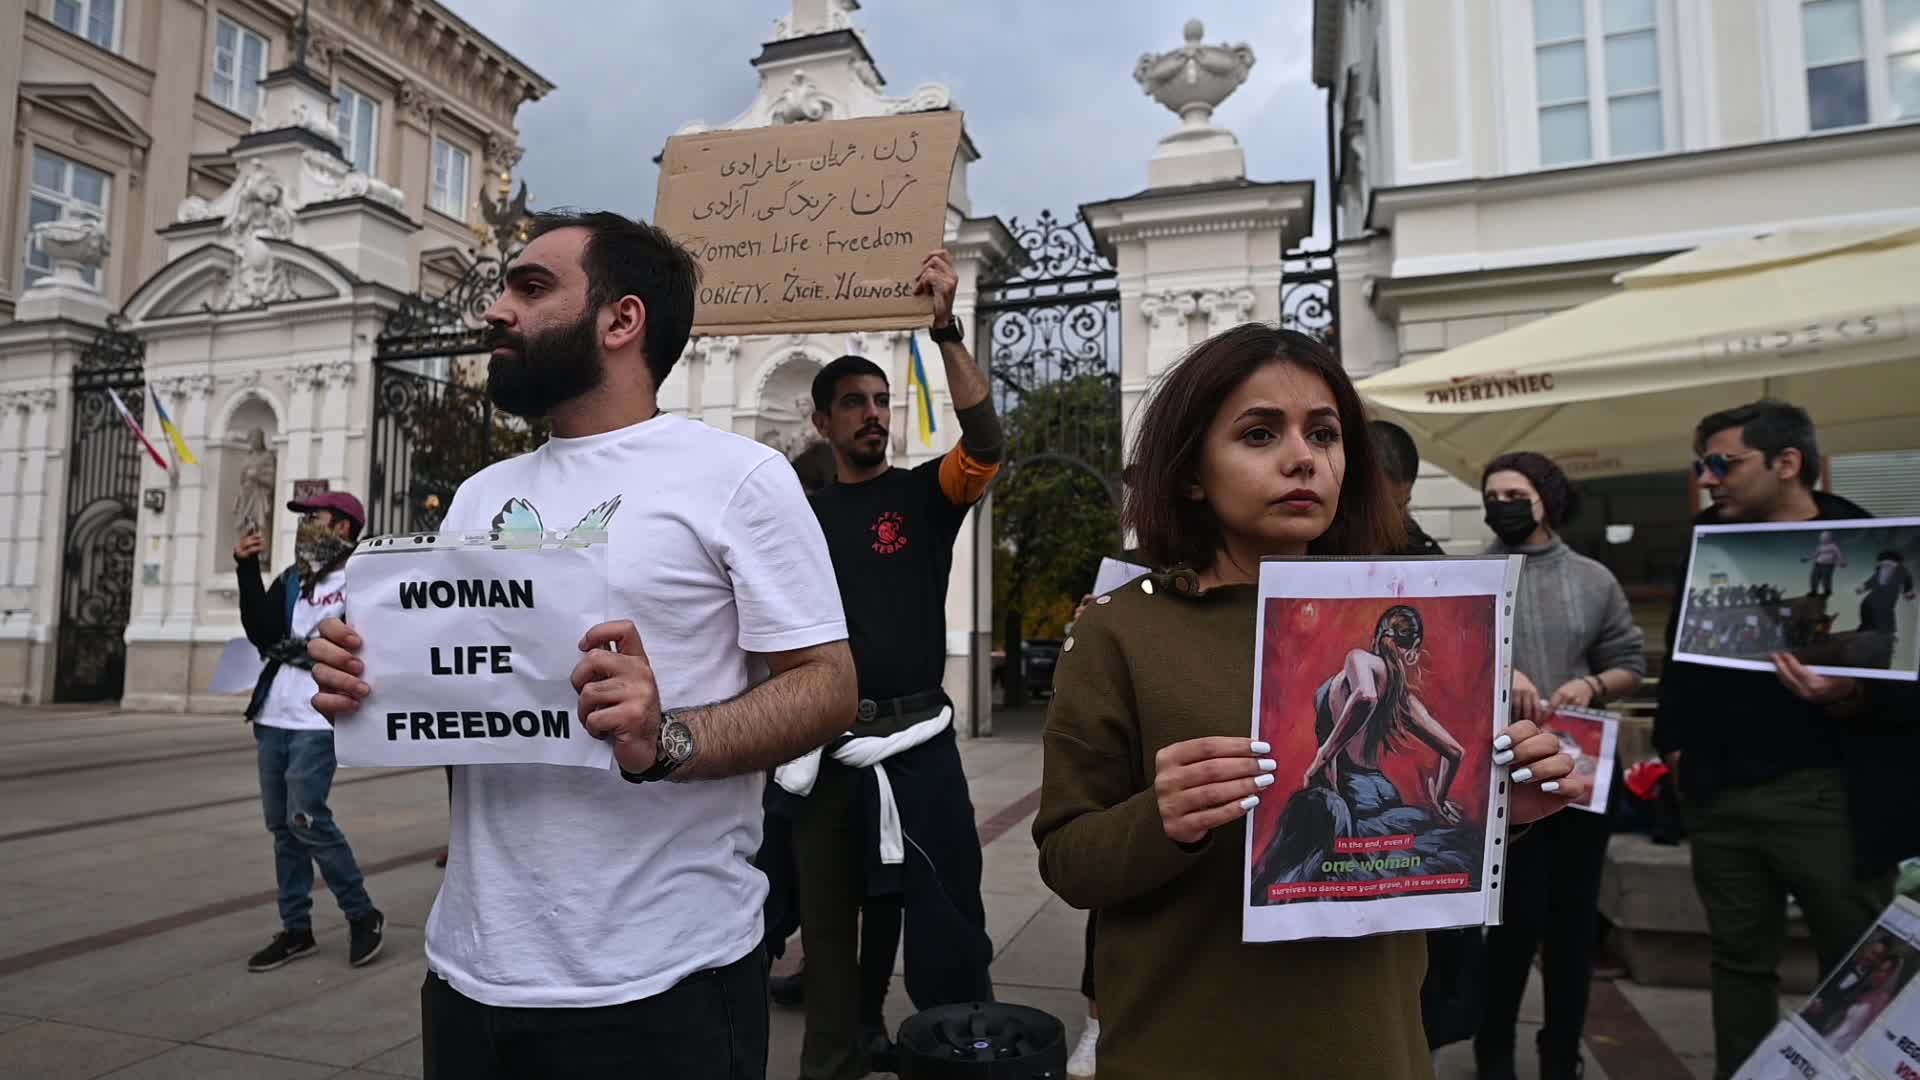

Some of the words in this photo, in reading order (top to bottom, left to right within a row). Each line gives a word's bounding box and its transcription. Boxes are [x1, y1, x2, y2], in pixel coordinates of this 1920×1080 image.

[826, 226, 912, 255] Freedom
[1425, 373, 1555, 404] ZWIERZYNIEC
[399, 579, 534, 609] WOMAN
[430, 645, 512, 675] LIFE
[386, 710, 570, 741] FREEDOM
[1338, 840, 1347, 848] In
[1349, 839, 1363, 848] the
[1364, 839, 1381, 848] end,
[1383, 838, 1402, 846] even
[1321, 860, 1356, 873] one
[1360, 855, 1421, 871] woman
[1271, 885, 1306, 895] survives
[1359, 883, 1377, 893] your
[1436, 876, 1464, 885] victory
